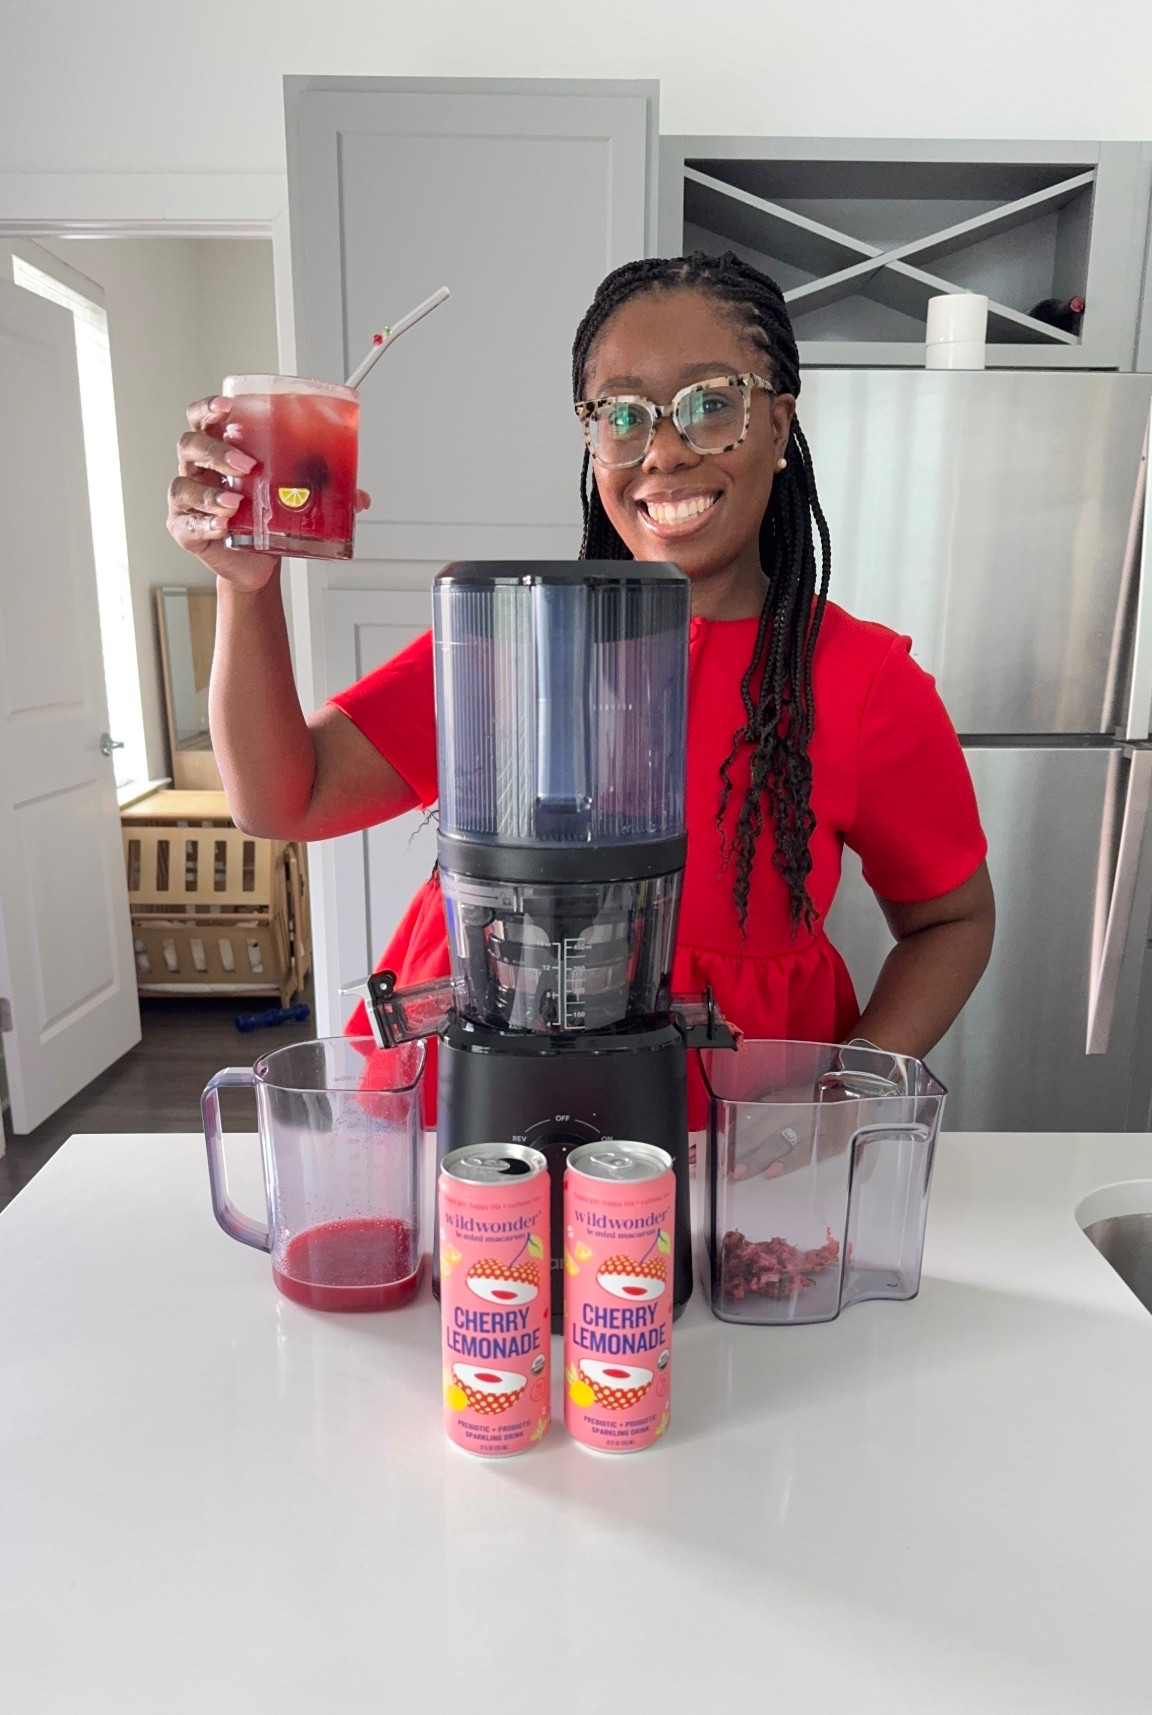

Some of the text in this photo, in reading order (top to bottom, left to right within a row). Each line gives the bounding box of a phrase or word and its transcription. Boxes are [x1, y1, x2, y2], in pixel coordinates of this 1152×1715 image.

[555, 1114, 571, 1122] OFF
[512, 1135, 527, 1143] REV
[445, 1212, 539, 1233] wildwonder
[574, 1209, 668, 1230] wildwonder
[463, 1232, 484, 1242] mini
[485, 1233, 526, 1243] macaron
[595, 1230, 617, 1239] mini
[617, 1229, 657, 1240] macaron
[454, 1306, 530, 1334] CHERRY
[582, 1302, 658, 1330] CHERRY
[446, 1325, 541, 1360] LEMONADE
[572, 1322, 667, 1356] LEMONADE
[457, 1418, 532, 1433] PREBIOTIC PROBIOTIC
[583, 1414, 657, 1428] PREBIOTIC PROBIOTIC
[465, 1430, 525, 1442] SPARKLING DRINK
[591, 1425, 650, 1437] SPARKLING DRINK
